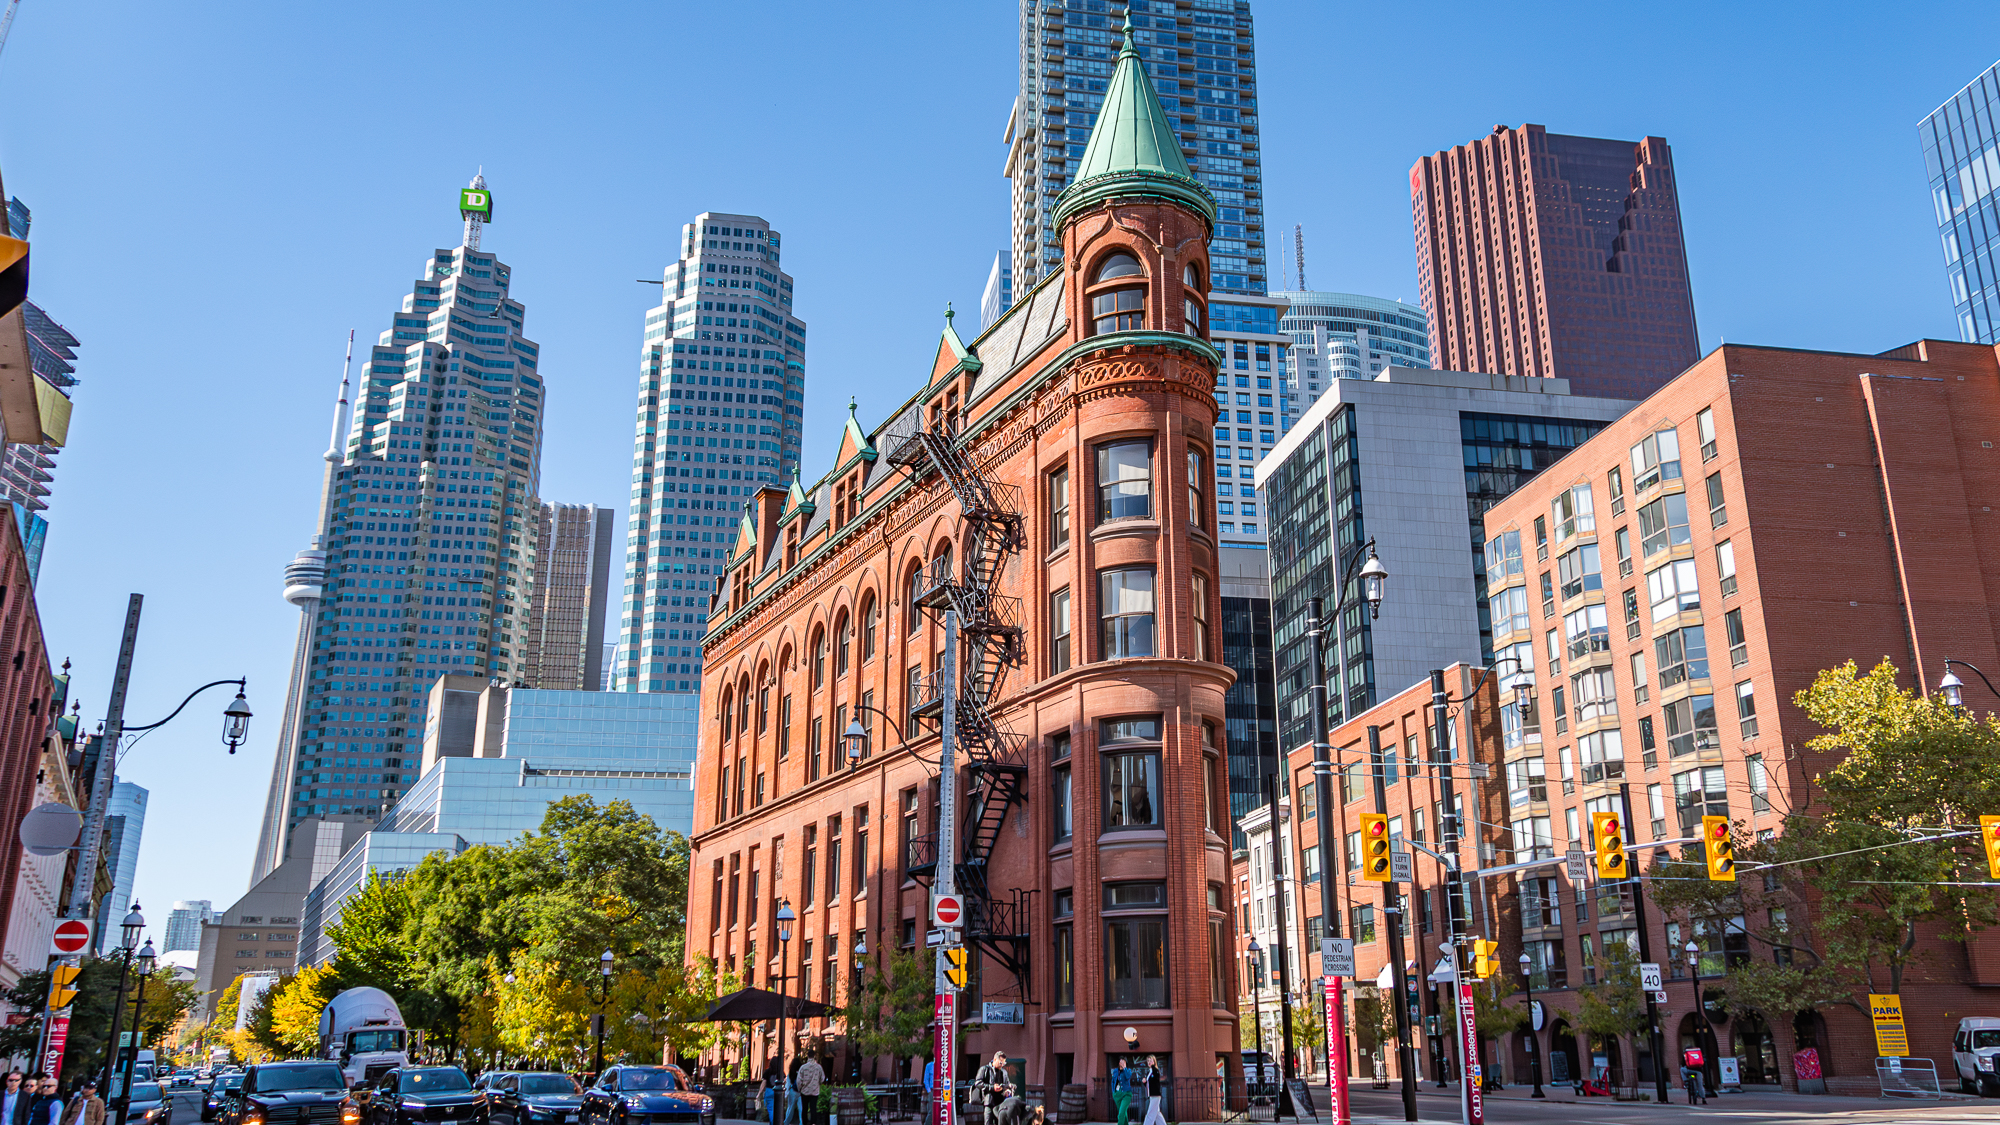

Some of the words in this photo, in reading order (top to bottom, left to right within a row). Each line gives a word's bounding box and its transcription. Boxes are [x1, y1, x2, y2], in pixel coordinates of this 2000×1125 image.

[463, 191, 486, 206] TD
[1331, 943, 1343, 954] NO
[1323, 954, 1352, 963] PEDESTRIAN
[1327, 963, 1350, 972] CROSSING
[1644, 975, 1659, 986] 40
[1873, 1007, 1900, 1015] PARK
[1326, 1003, 1334, 1056] TORONTO
[1467, 1018, 1476, 1062] TORONTO
[44, 1050, 58, 1079] ONTO
[1328, 1059, 1337, 1095] TOWN
[1472, 1095, 1482, 1118] OLD
